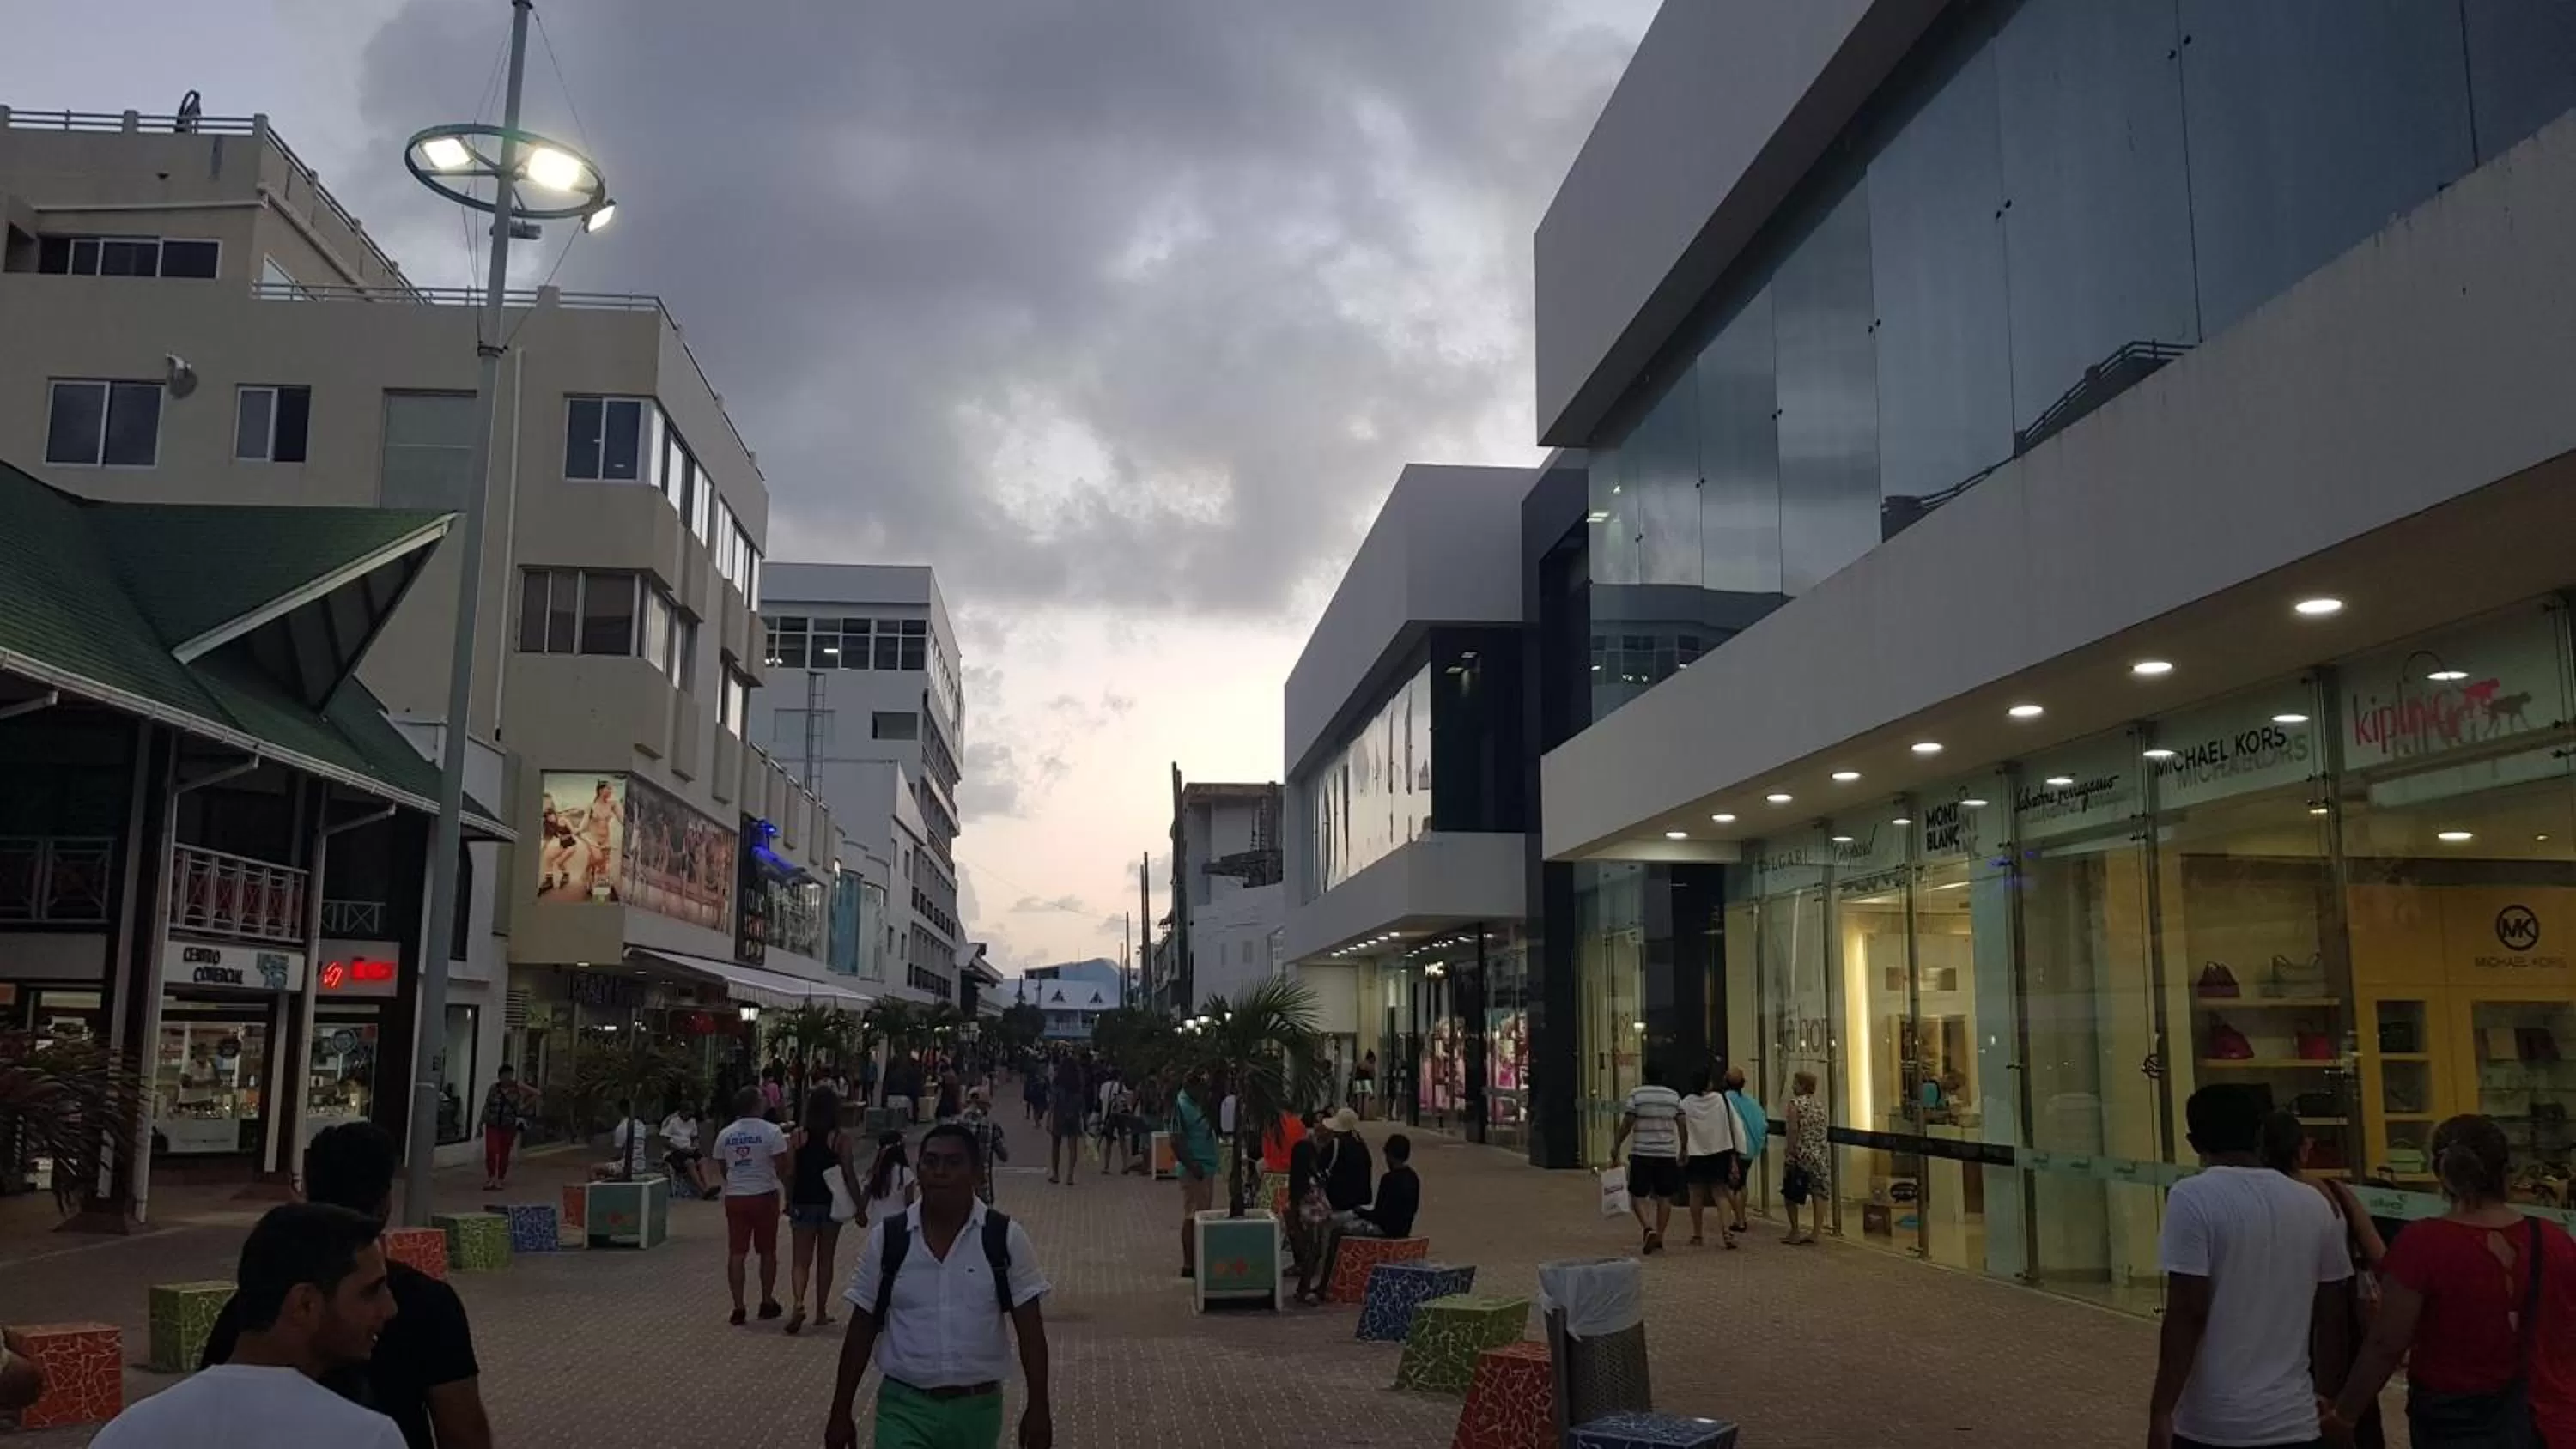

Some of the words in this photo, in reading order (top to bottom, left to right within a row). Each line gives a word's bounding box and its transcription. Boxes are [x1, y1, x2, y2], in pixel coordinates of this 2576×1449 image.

[2353, 678, 2463, 754] kipling
[2154, 738, 2229, 777] MICHAEL
[2235, 726, 2287, 757] KORS
[1926, 802, 1959, 830] MONT
[1927, 824, 1960, 852] BLANC
